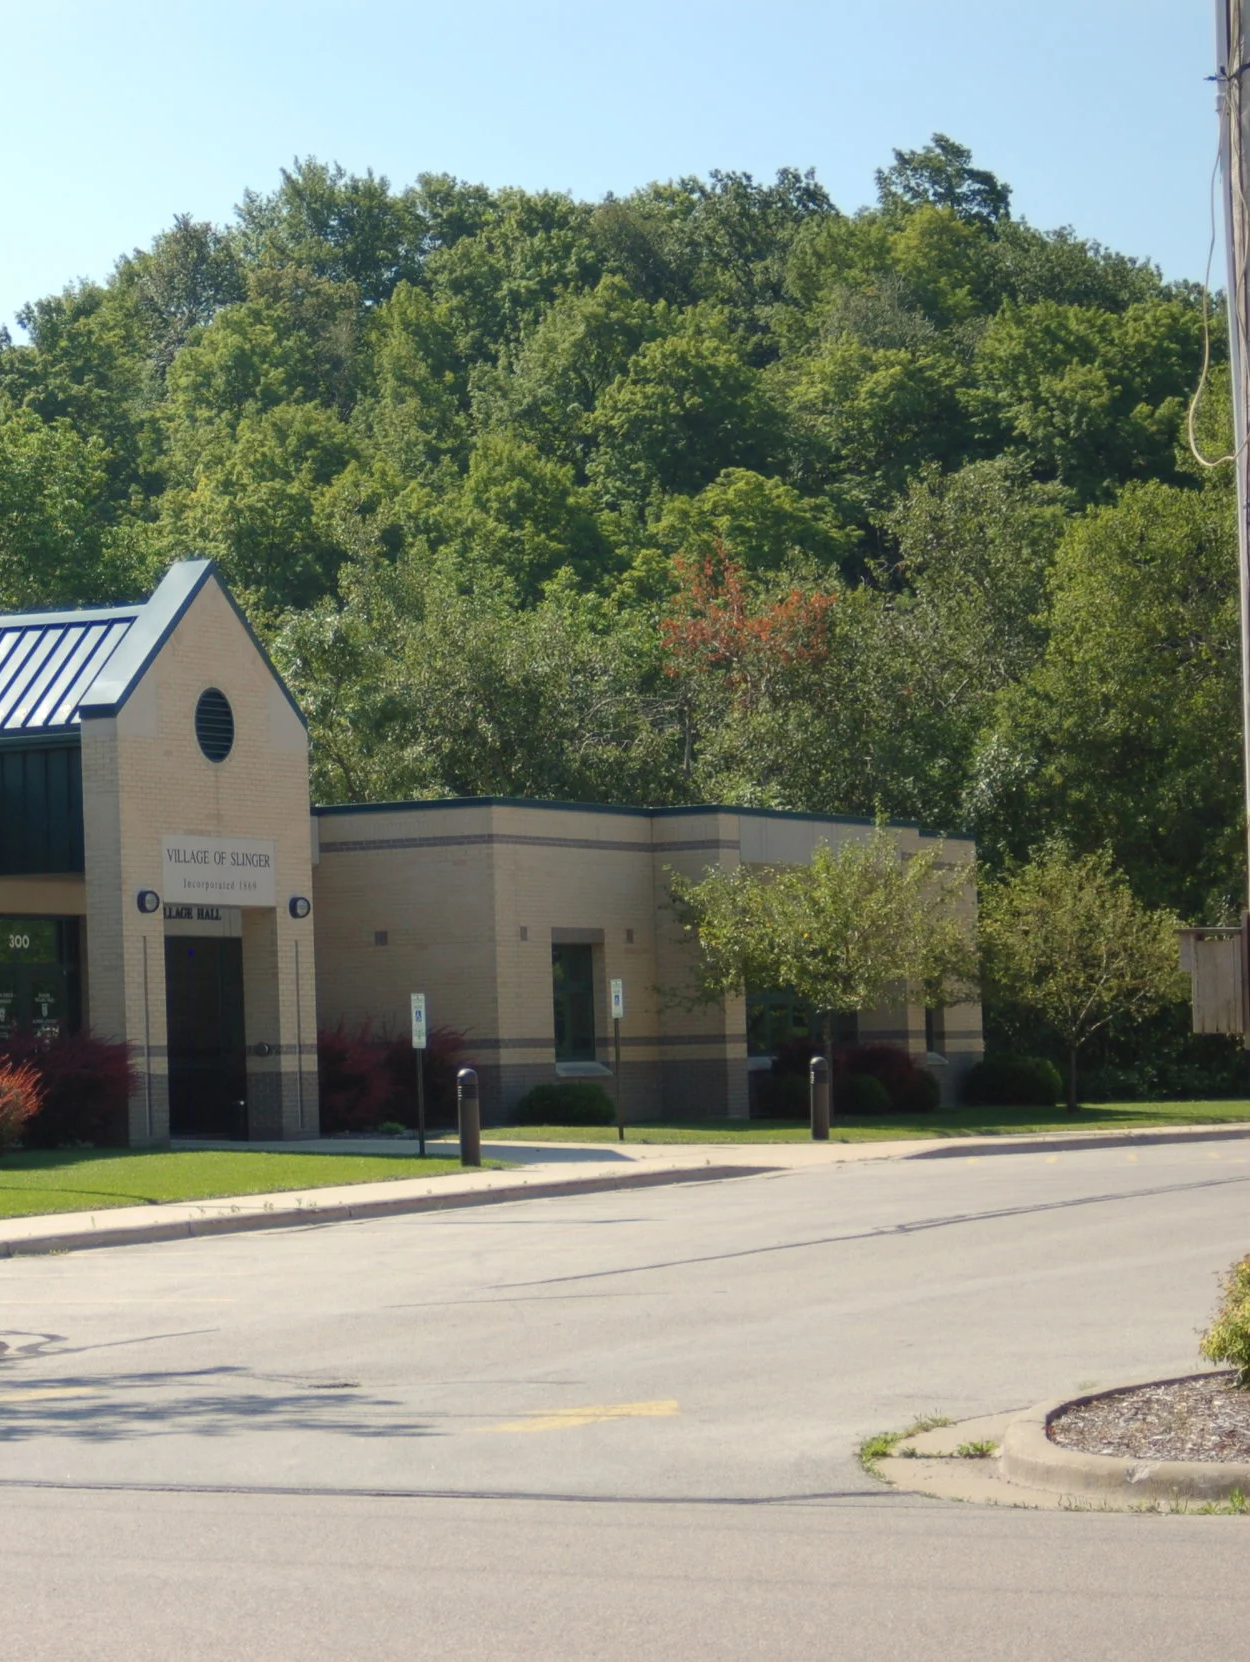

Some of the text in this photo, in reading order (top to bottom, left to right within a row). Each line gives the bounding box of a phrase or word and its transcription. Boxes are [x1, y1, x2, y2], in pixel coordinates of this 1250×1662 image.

[167, 848, 271, 868] VILLAGE OF SLINGER
[183, 878, 235, 891] Incorporated
[163, 907, 222, 920] LLAGE HALL
[9, 934, 30, 949] 300
